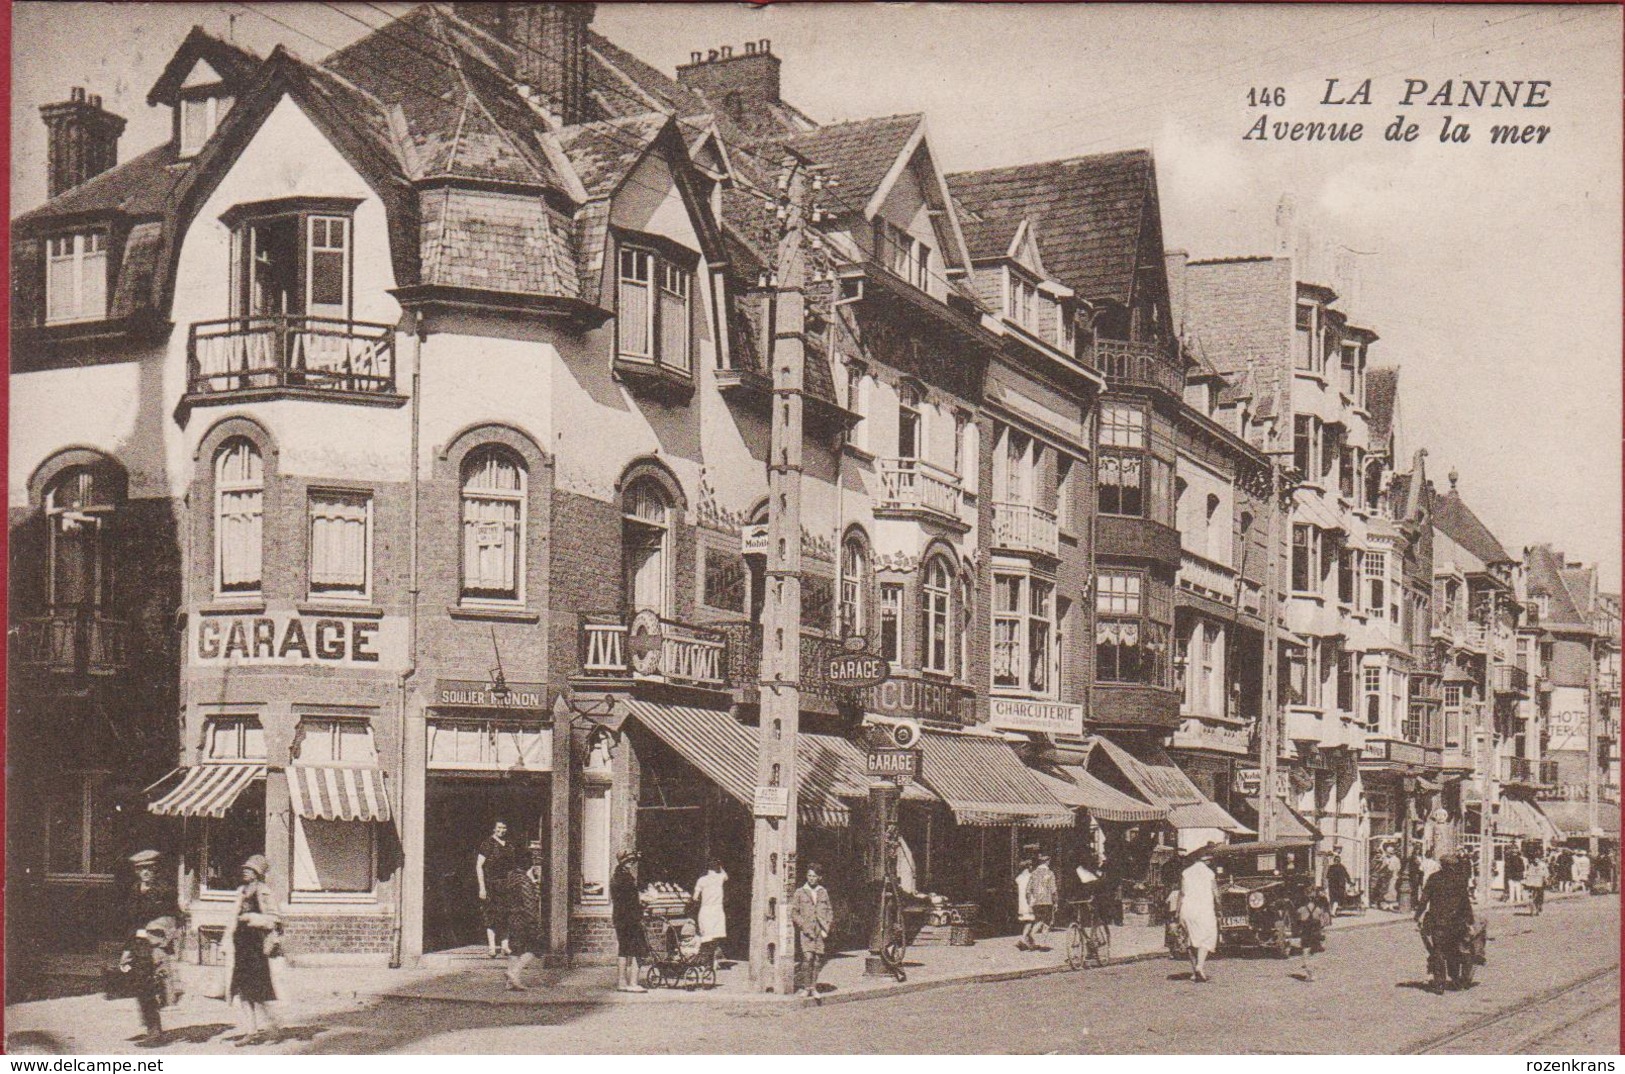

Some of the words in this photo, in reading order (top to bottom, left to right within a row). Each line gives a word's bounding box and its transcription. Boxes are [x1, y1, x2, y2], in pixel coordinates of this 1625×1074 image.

[198, 618, 380, 662] GARAGE
[830, 660, 880, 679] GARAGE
[442, 690, 485, 704] SOULIER
[996, 702, 1074, 721] CHARCUTERIE
[1549, 710, 1588, 724] HOTE
[868, 754, 912, 771] GARAGE
